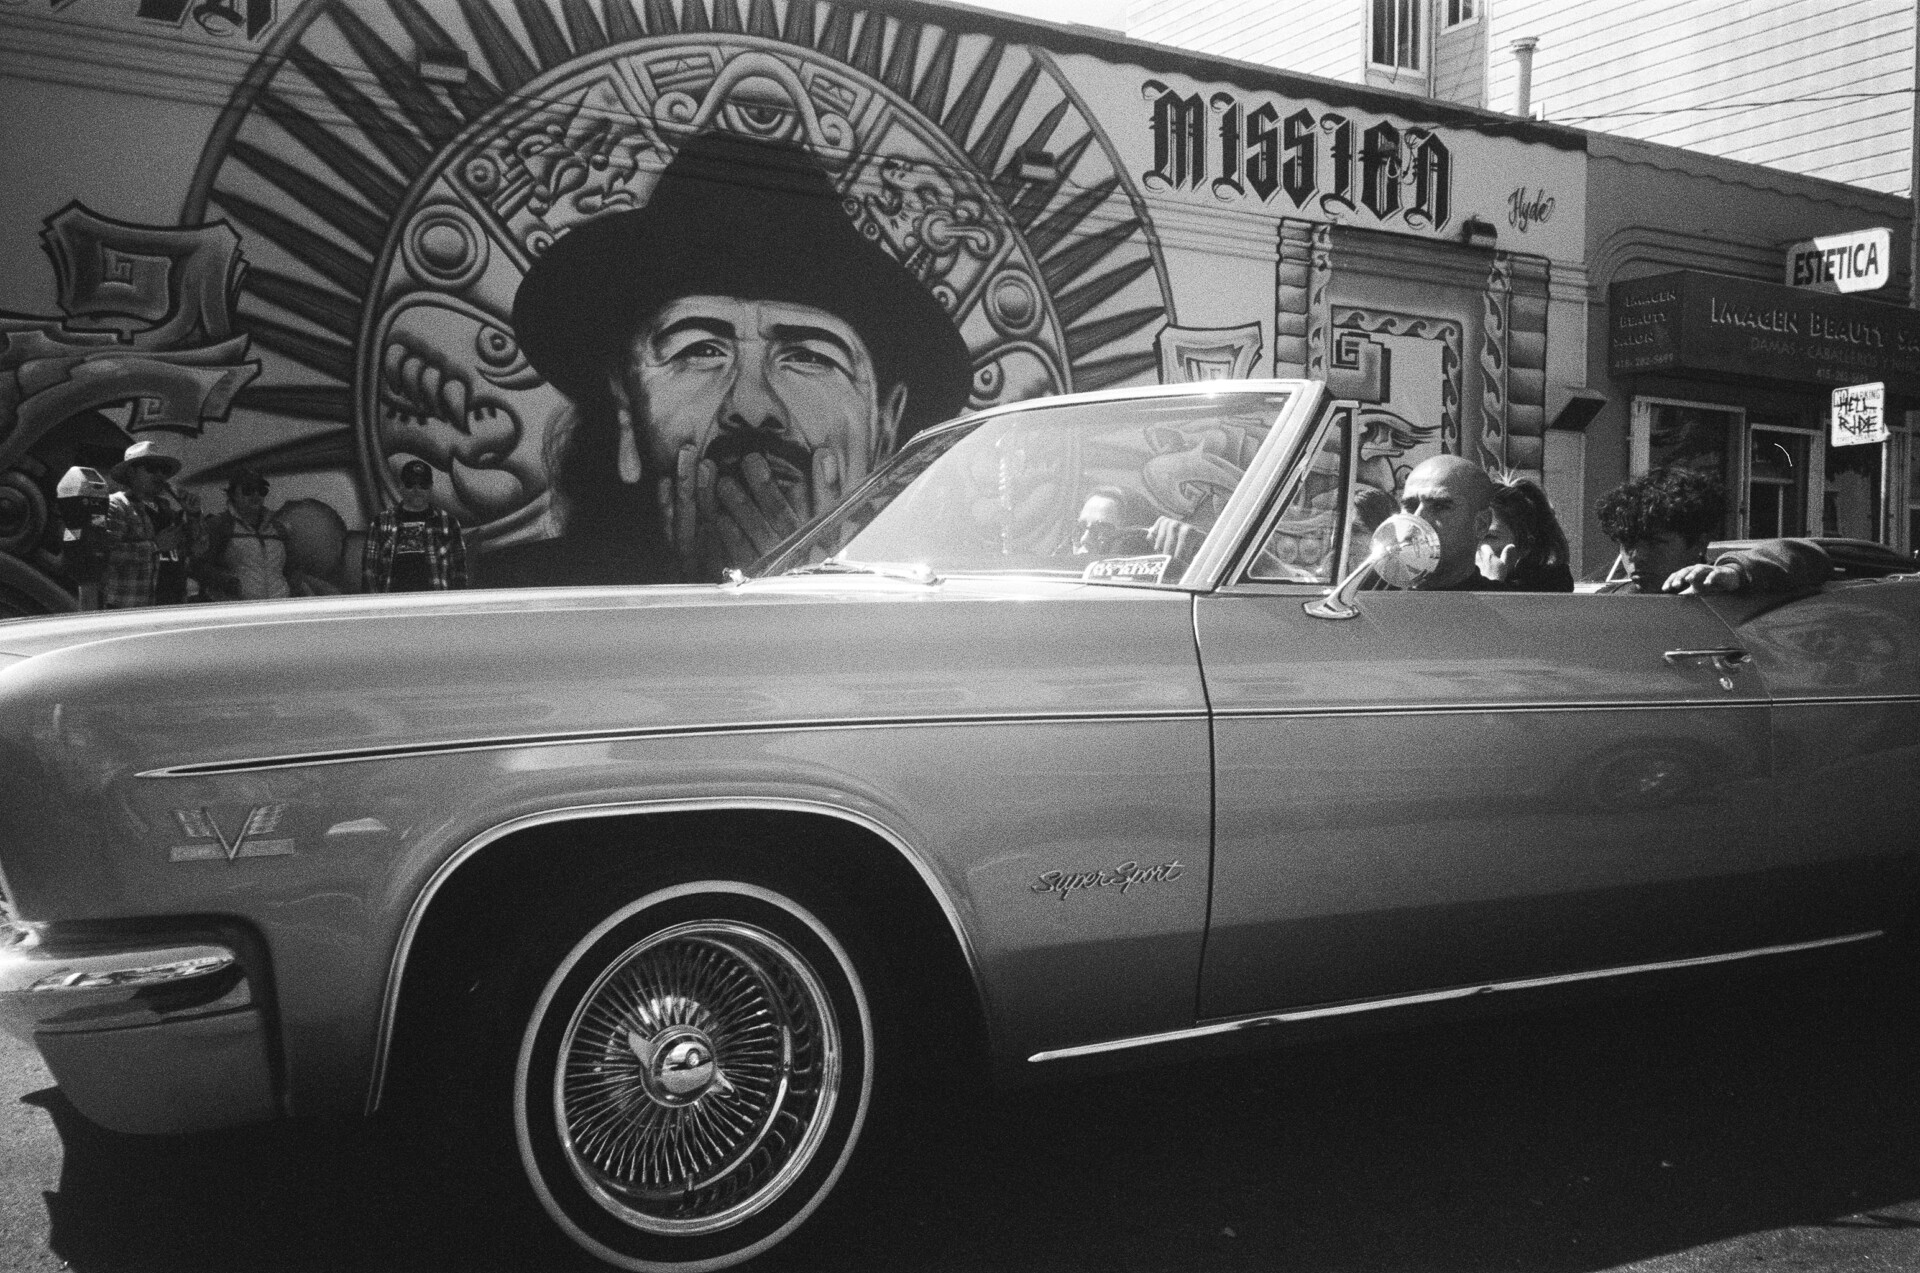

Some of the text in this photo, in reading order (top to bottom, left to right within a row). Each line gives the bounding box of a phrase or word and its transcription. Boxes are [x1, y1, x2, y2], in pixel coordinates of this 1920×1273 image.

[1793, 242, 1879, 286] ESTETICA
[1031, 860, 1186, 901] Super Sport
